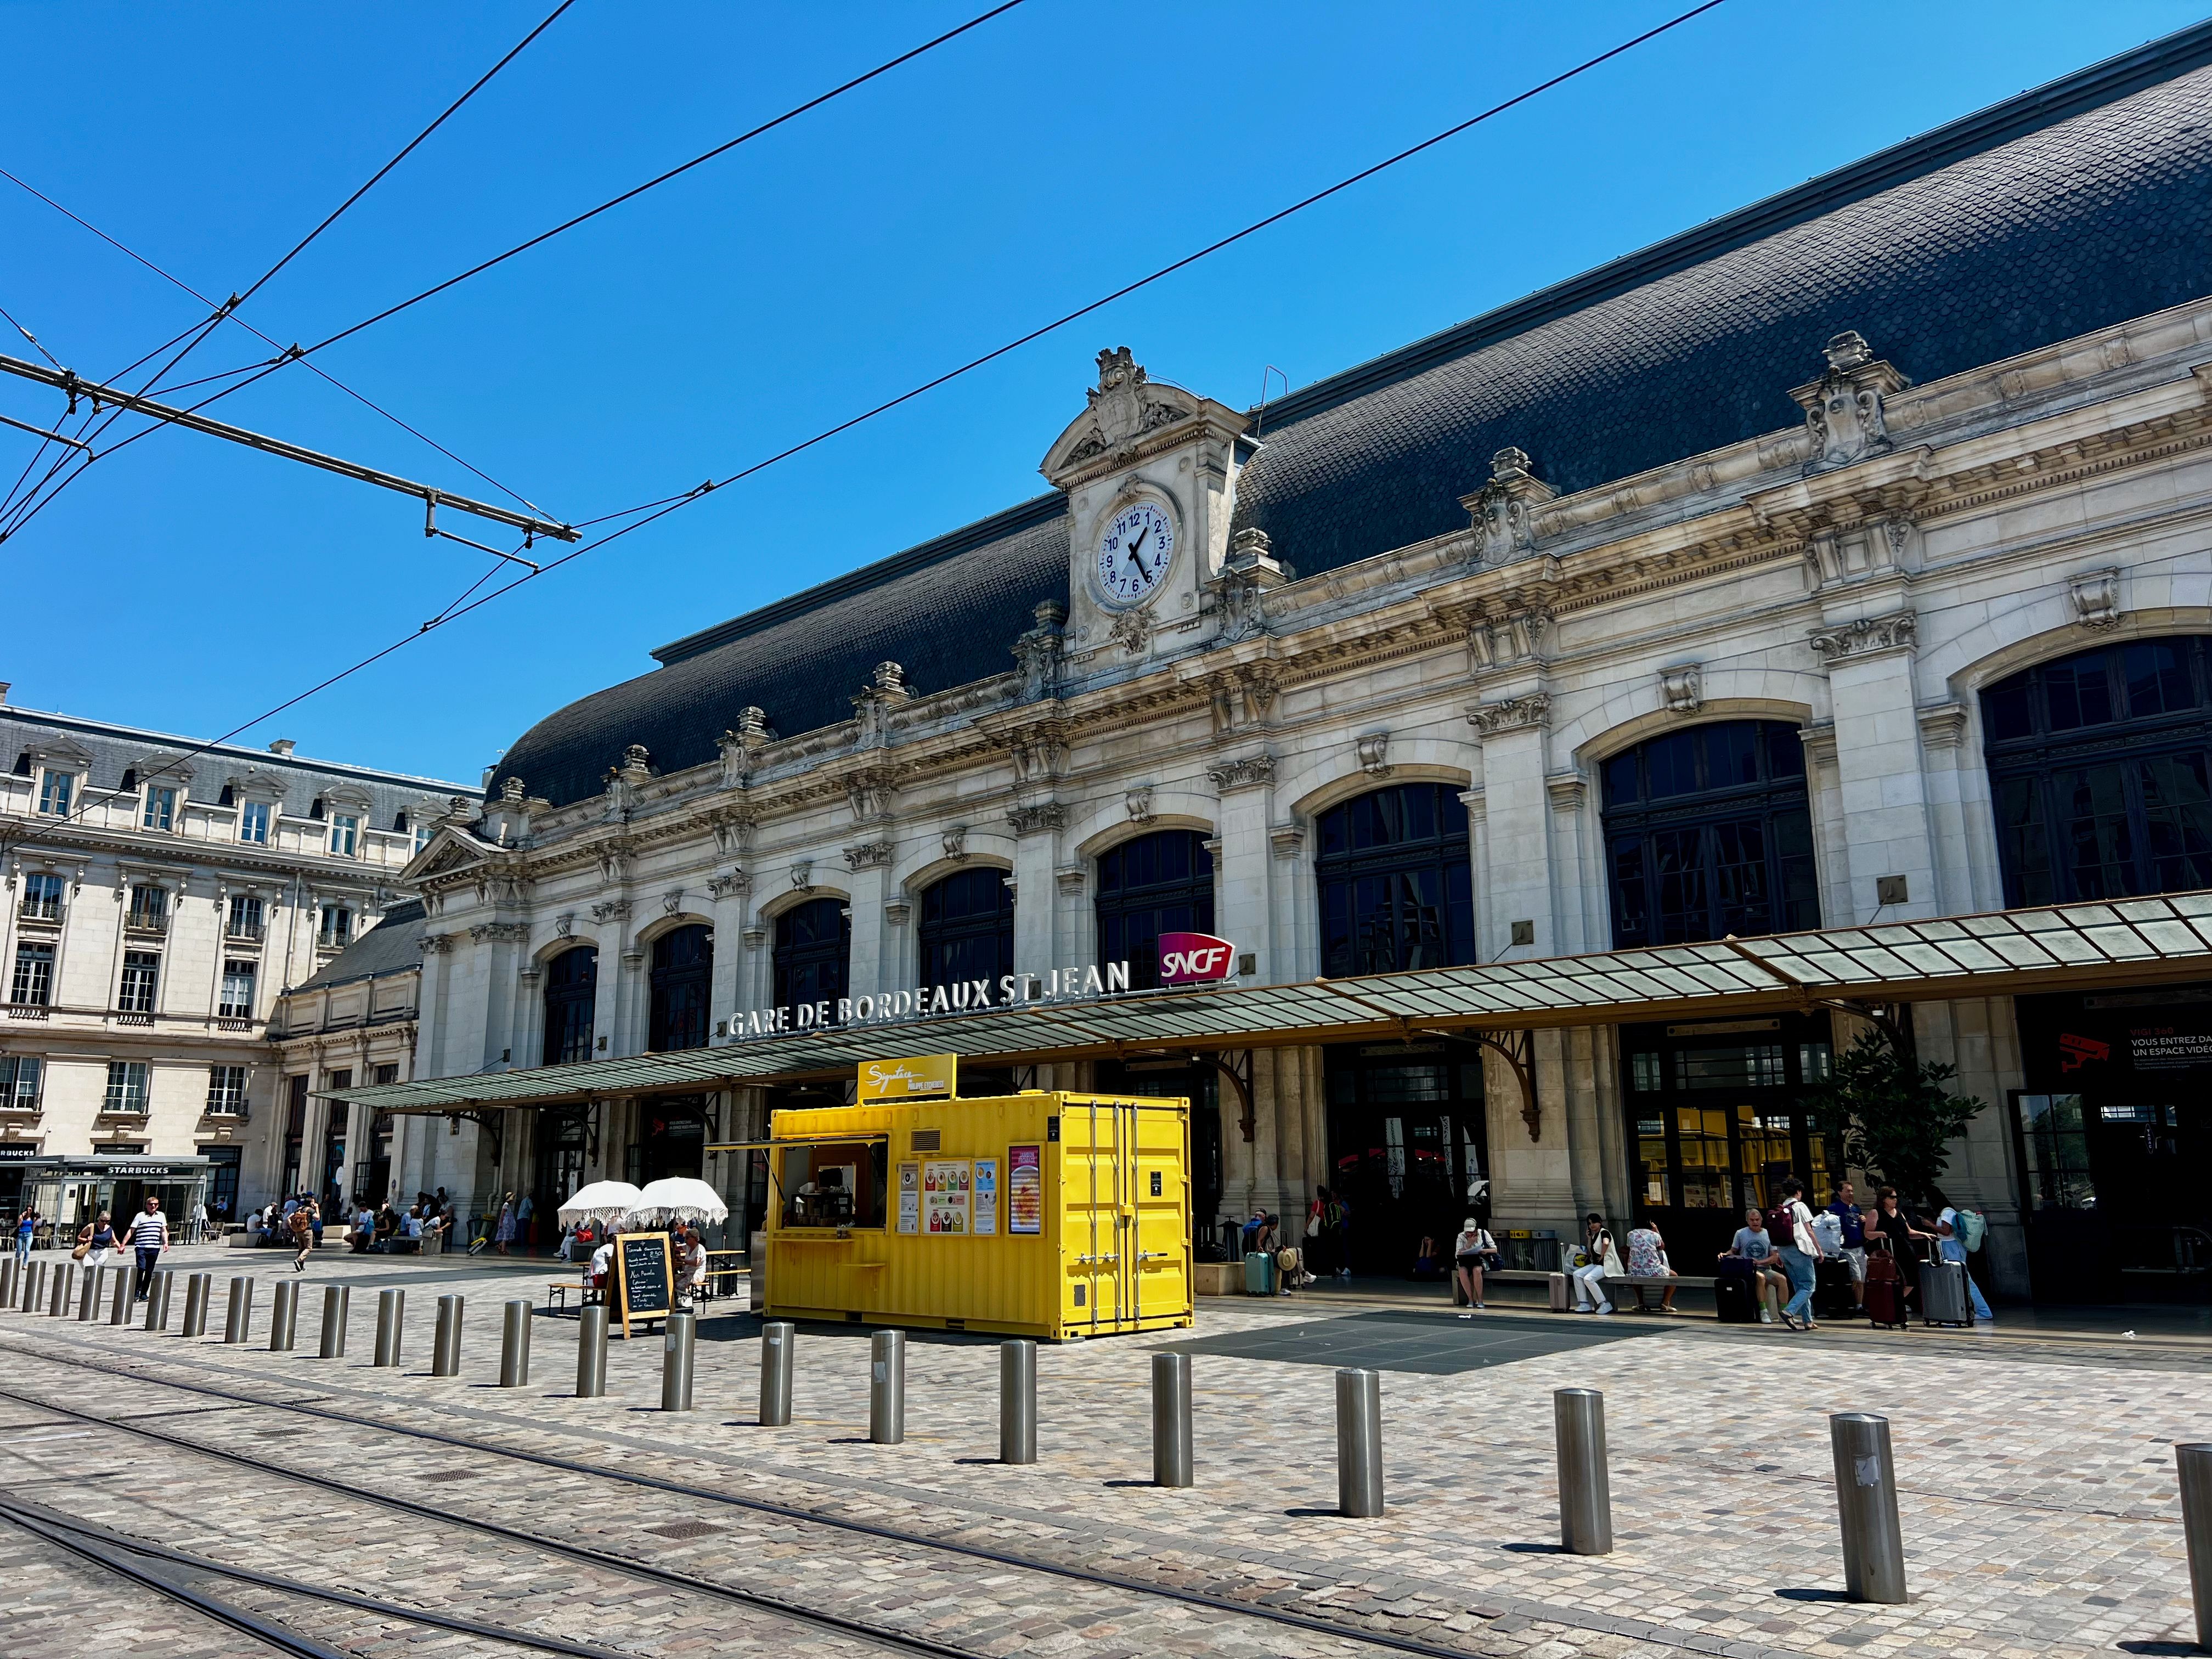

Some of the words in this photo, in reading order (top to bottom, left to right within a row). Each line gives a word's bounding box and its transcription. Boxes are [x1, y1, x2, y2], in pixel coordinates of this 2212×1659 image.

[1128, 512, 1140, 527] 12
[1145, 511, 1150, 525] 1
[1116, 521, 1126, 535] 11
[1154, 520, 1161, 534] 2
[1108, 537, 1118, 551] 10
[1159, 536, 1165, 549] 3
[1107, 555, 1113, 568] 9
[1154, 553, 1161, 567] 4
[1110, 571, 1116, 583] 8
[1146, 570, 1153, 584] 5
[1120, 578, 1126, 592] 7
[1132, 579, 1139, 592] 6
[1160, 946, 1226, 979] SNCF
[729, 1007, 790, 1036] GARE
[797, 1001, 830, 1028] DE
[838, 979, 990, 1024] BORDEAUX
[1000, 973, 1035, 1003] ST
[1043, 961, 1129, 999] JEAN
[2154, 1027, 2174, 1035] 360
[2131, 1038, 2158, 1046] VOUS
[2159, 1036, 2197, 1045] ENTREZ
[2149, 1047, 2186, 1056] ESPACE
